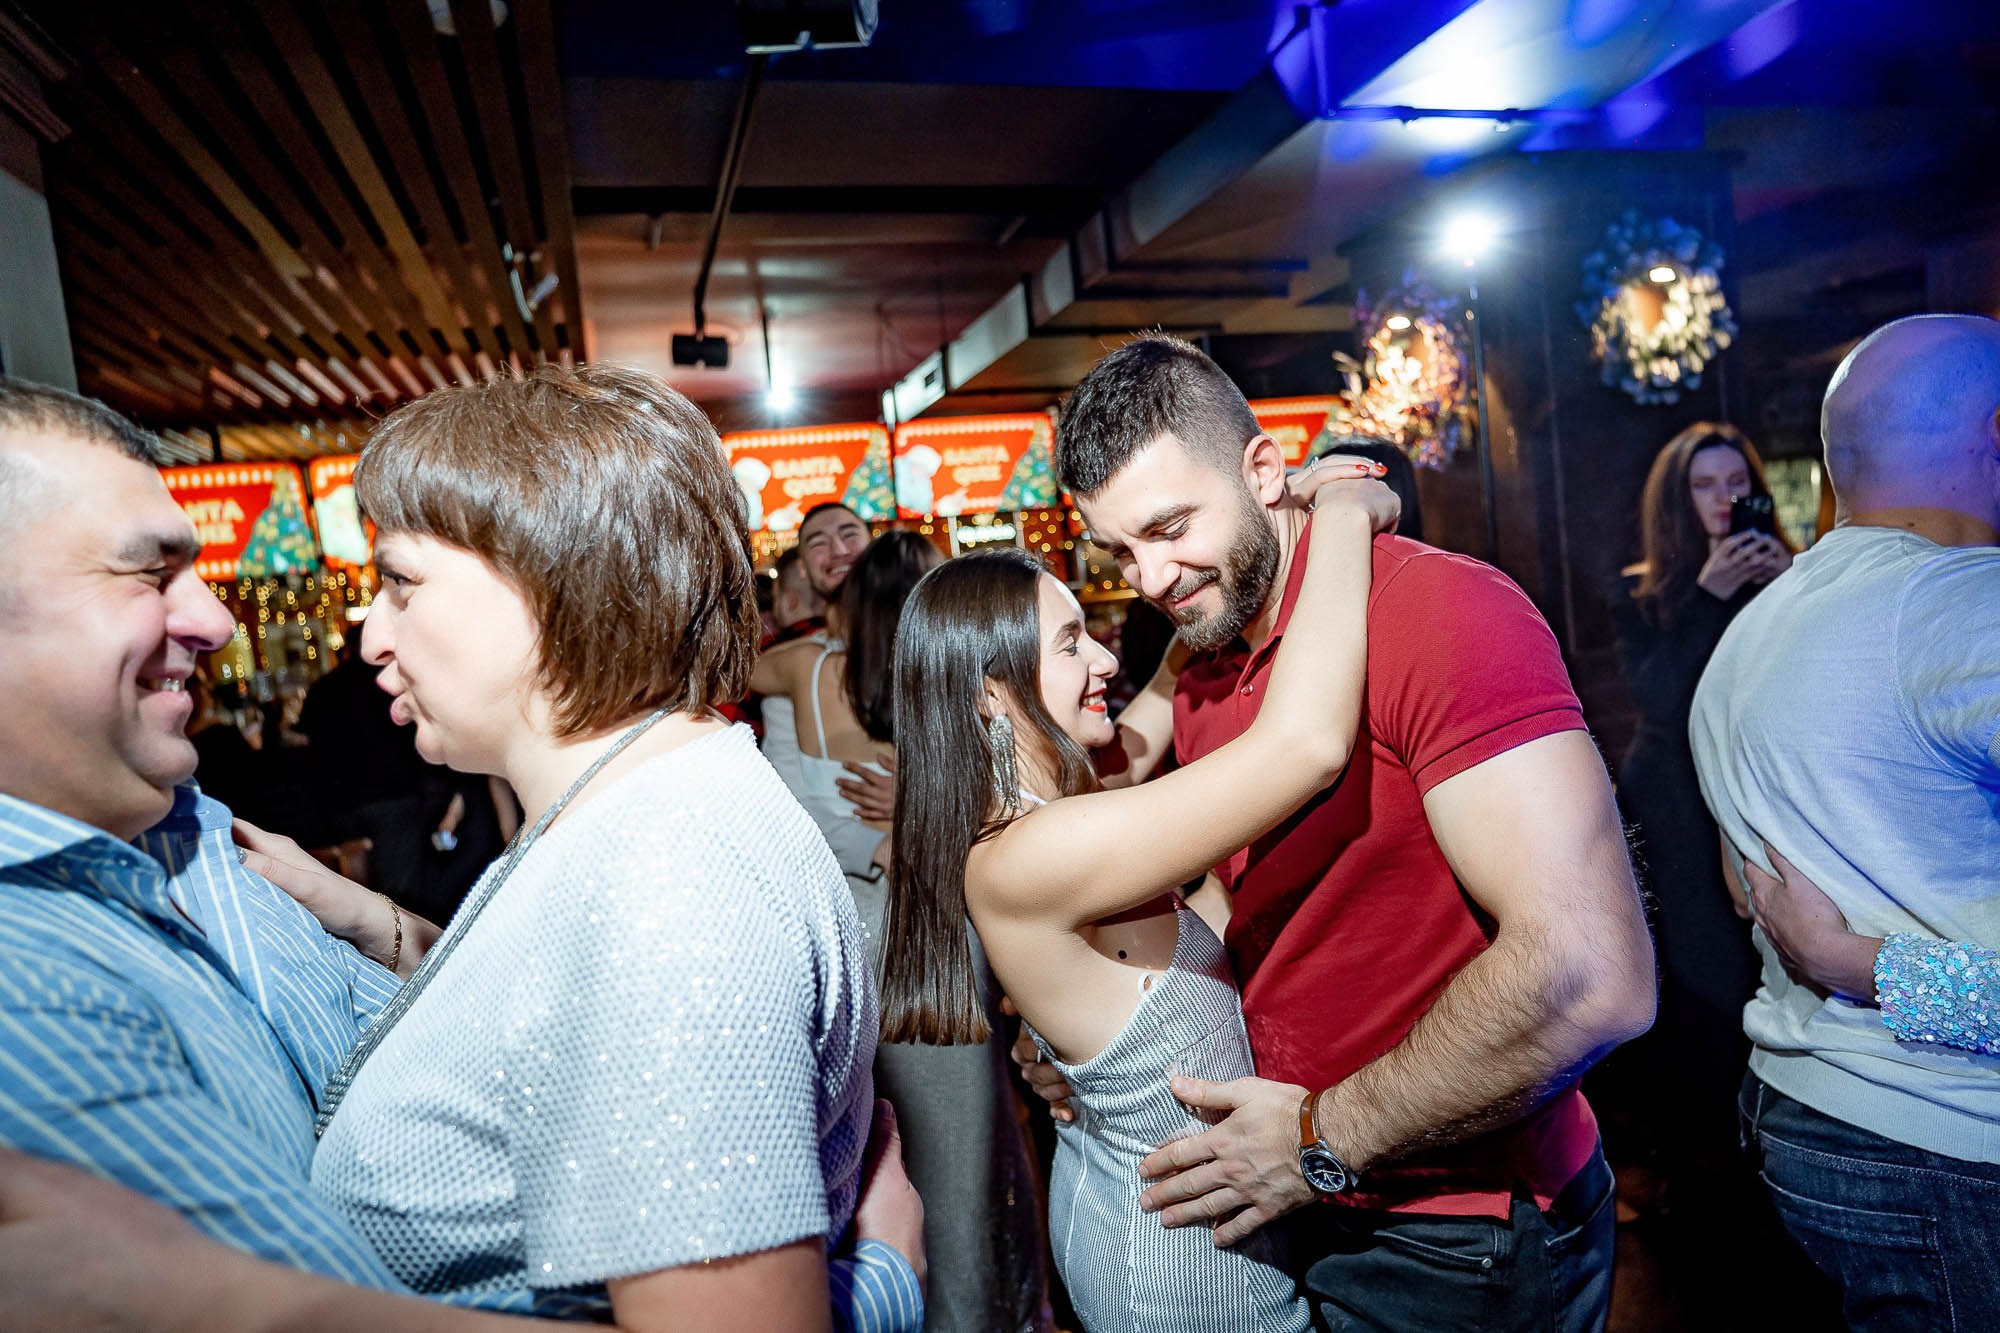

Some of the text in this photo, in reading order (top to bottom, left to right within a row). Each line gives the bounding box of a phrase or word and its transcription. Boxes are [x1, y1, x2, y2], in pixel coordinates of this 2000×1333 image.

[772, 454, 845, 479] SANTA
[943, 445, 1009, 467] SANTA
[184, 498, 246, 521] NTA
